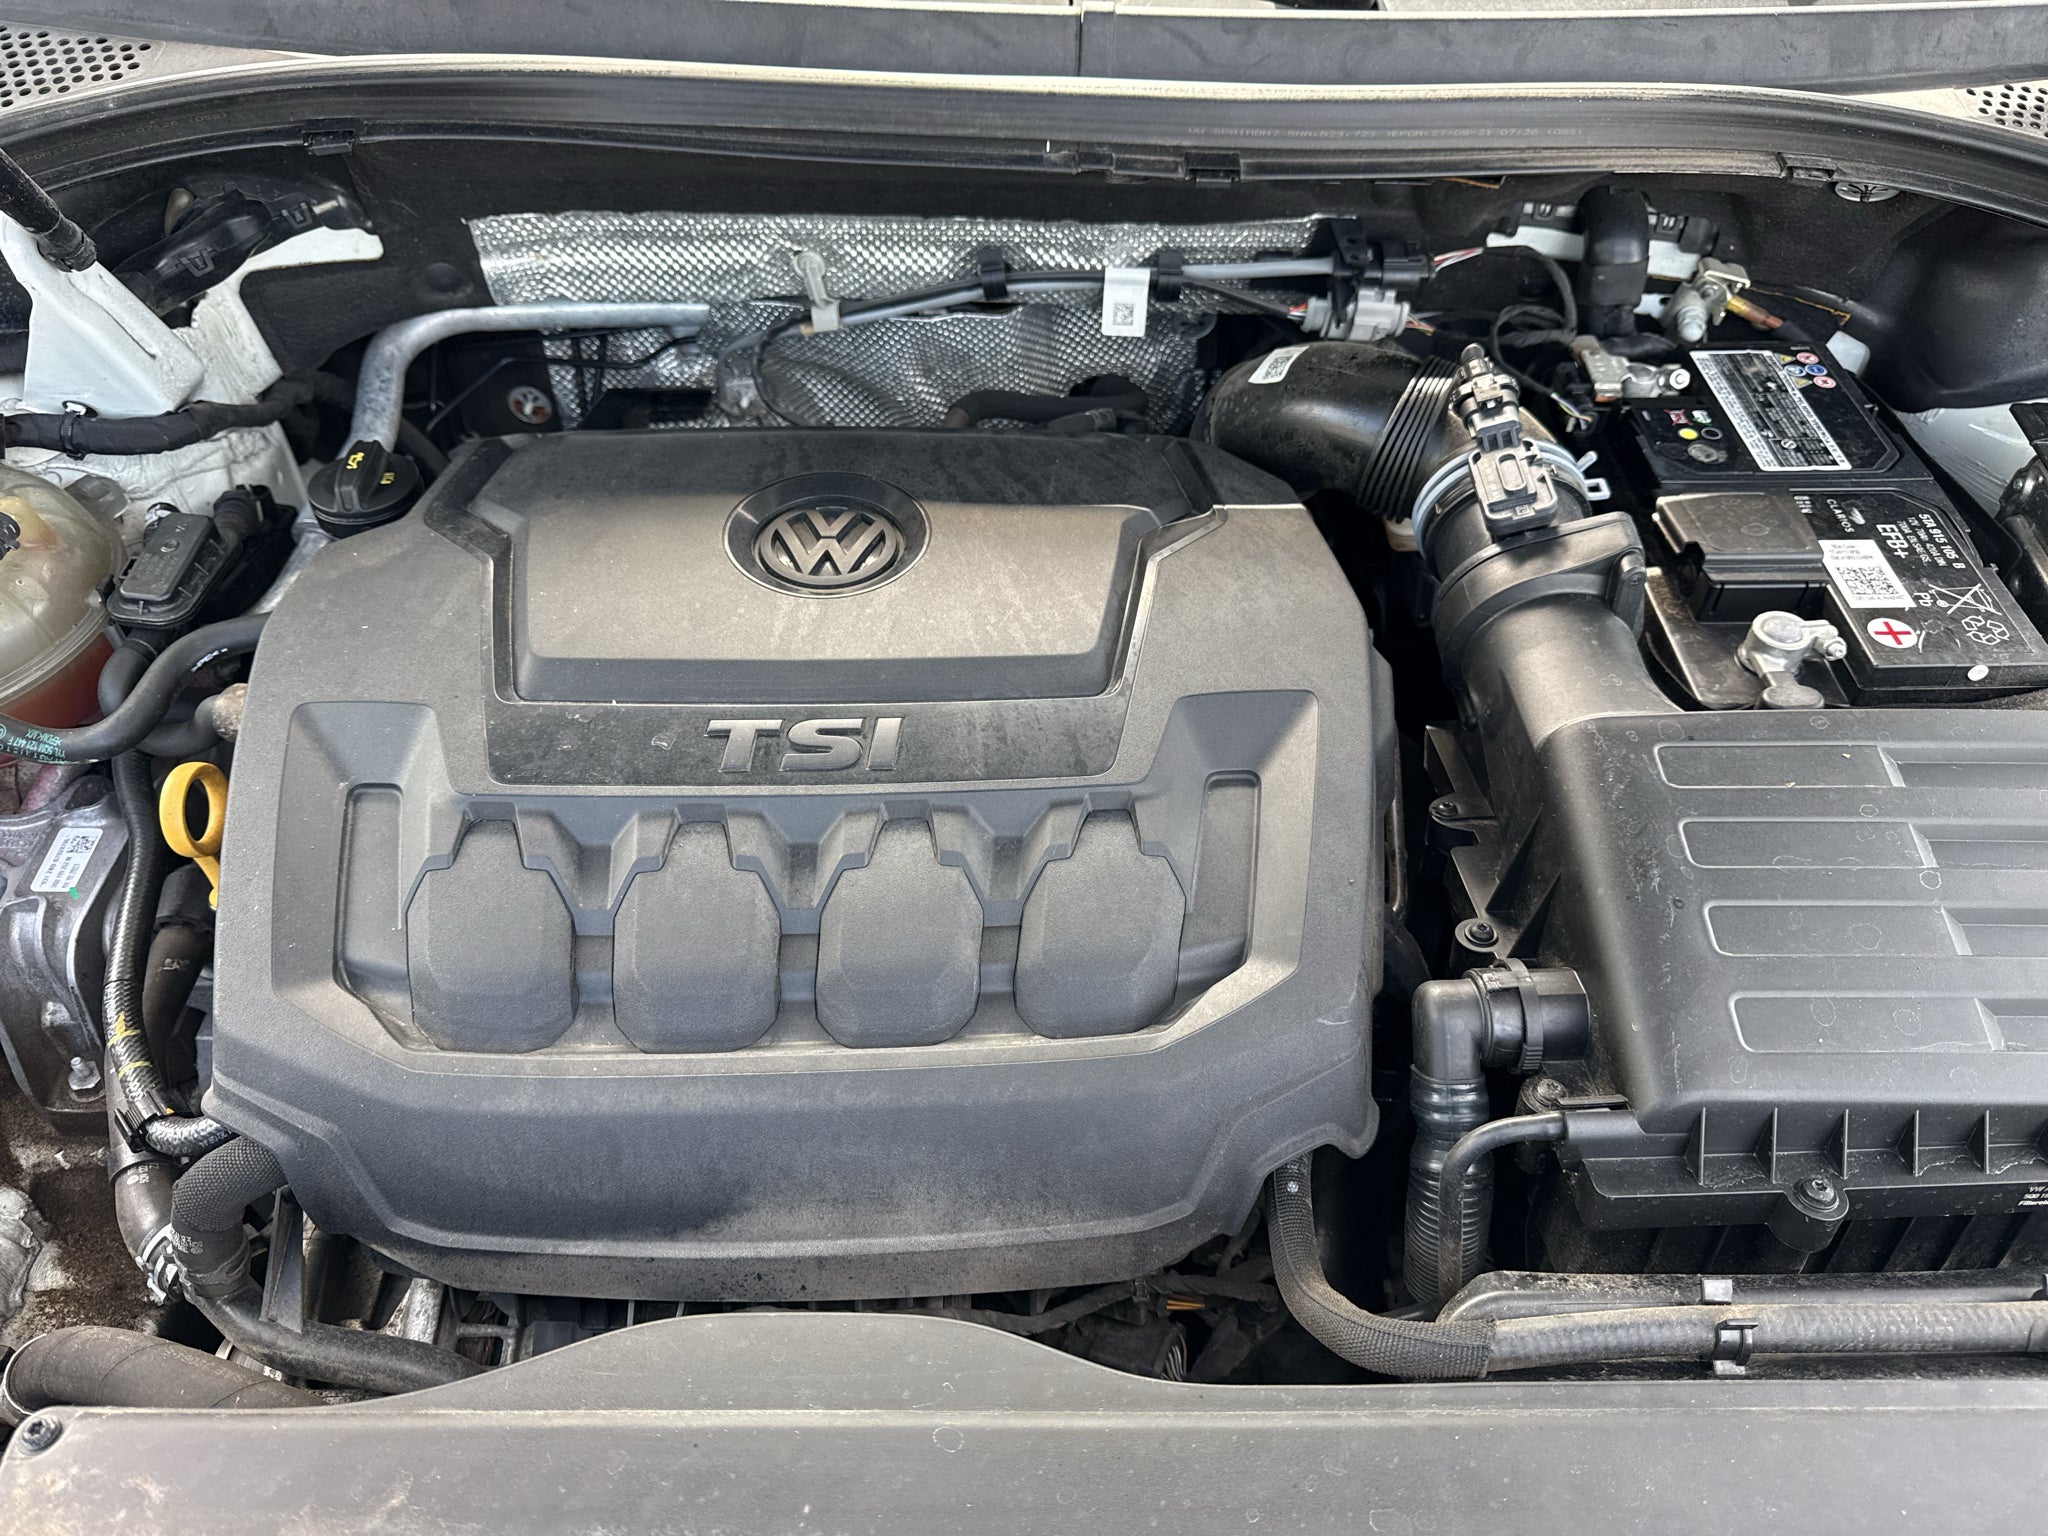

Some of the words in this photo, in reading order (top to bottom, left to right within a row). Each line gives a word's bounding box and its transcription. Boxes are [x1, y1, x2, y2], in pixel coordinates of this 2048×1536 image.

[1826, 498, 1855, 533] CLARIOS
[1876, 524, 1910, 559] EFB+
[1918, 513, 1937, 528] 5TA
[1928, 528, 1948, 543] 915
[1940, 545, 1959, 559] 105
[1913, 592, 1934, 607] Pb
[704, 716, 906, 772] TSI
